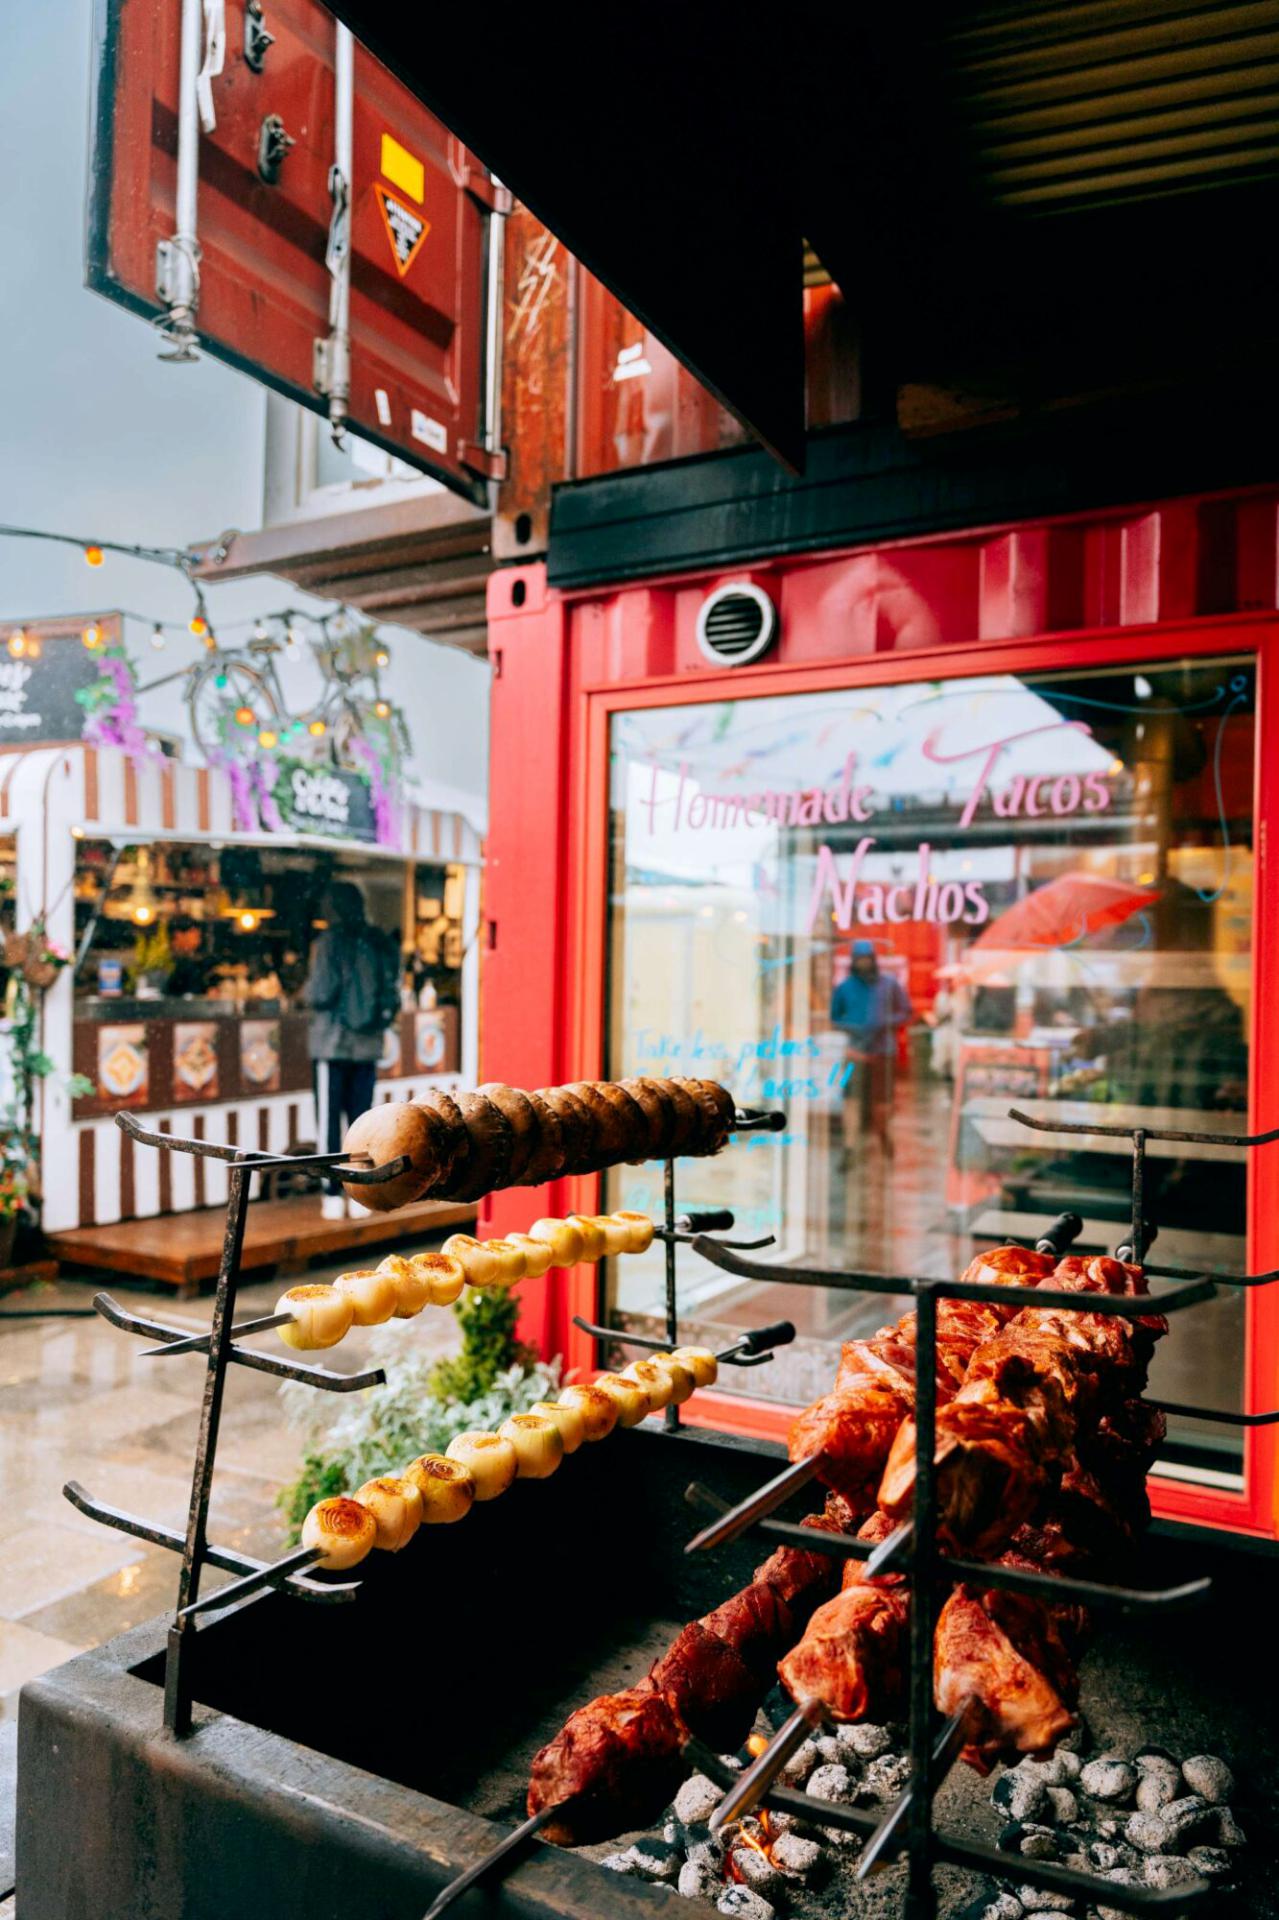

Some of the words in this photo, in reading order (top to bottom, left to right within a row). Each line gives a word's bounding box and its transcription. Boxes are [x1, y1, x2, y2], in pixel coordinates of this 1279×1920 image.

[641, 751, 876, 835] Homemade
[922, 720, 1112, 828] Tacos
[806, 837, 990, 932] Nachos
